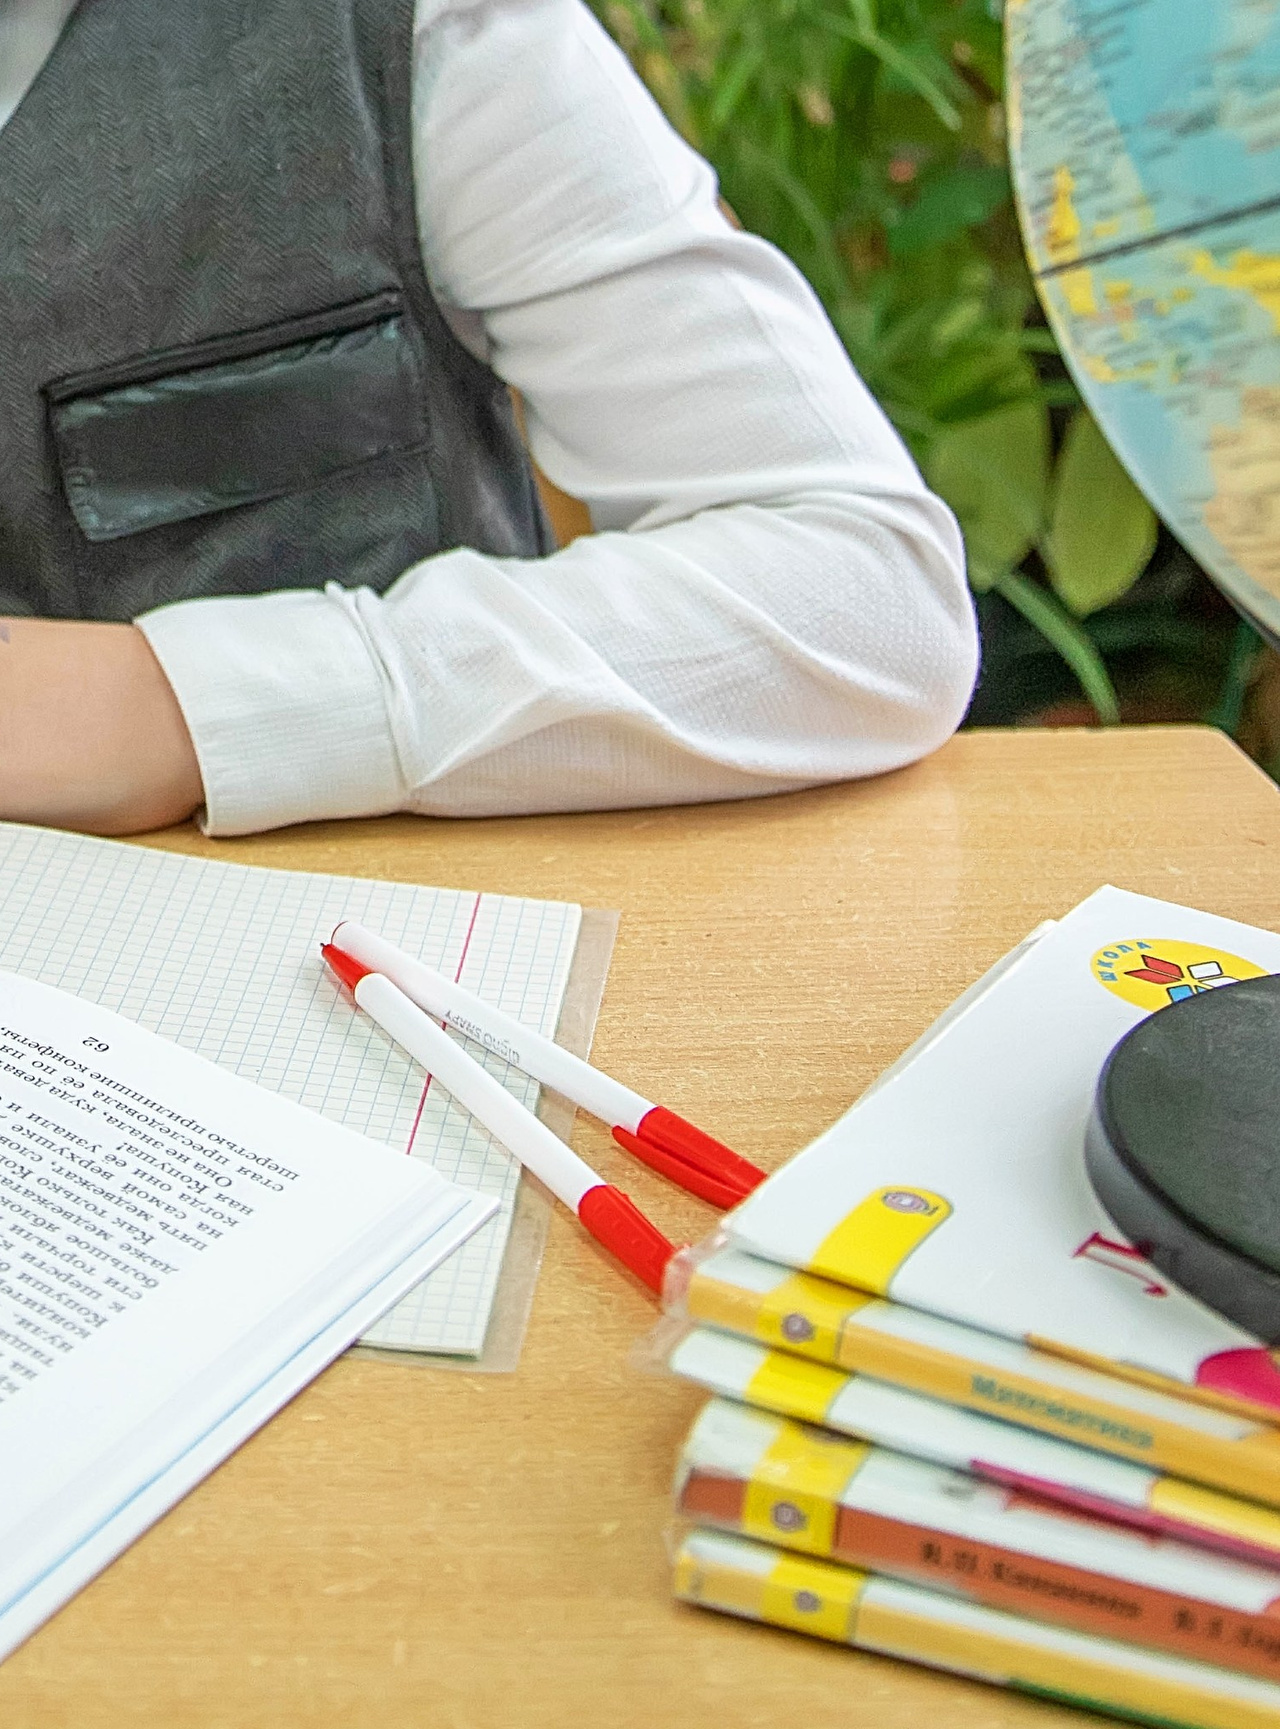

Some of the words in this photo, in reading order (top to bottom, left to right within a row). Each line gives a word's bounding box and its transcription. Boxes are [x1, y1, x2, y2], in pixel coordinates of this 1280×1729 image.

[1096, 941, 1152, 982] ШКОЛА
[0, 1026, 89, 1074] конфеты,
[82, 1036, 110, 1053] 62
[31, 1060, 58, 1075] по
[59, 1076, 85, 1089] её
[6, 1102, 23, 1113] и
[48, 1085, 97, 1114] куда
[89, 1072, 207, 1135] прилипшие
[25, 1112, 103, 1154] узнали
[91, 1089, 230, 1166] преследовала
[102, 1111, 165, 1150] знала,
[11, 1124, 115, 1181] верхушке
[101, 1153, 128, 1168] её
[165, 1148, 192, 1164] не
[207, 1133, 300, 1181] шерстью
[115, 1142, 210, 1195] Копуша!
[131, 1167, 173, 1192] они
[193, 1161, 233, 1188] Она
[235, 1165, 285, 1192] стая
[36, 1177, 108, 1219] только
[50, 1161, 155, 1222] медвежат,
[120, 1182, 187, 1220] самой
[213, 1192, 254, 1216] ная
[178, 1192, 240, 1228] когда
[111, 1216, 156, 1246] Как
[158, 1221, 208, 1251] пять
[196, 1221, 224, 1240] на
